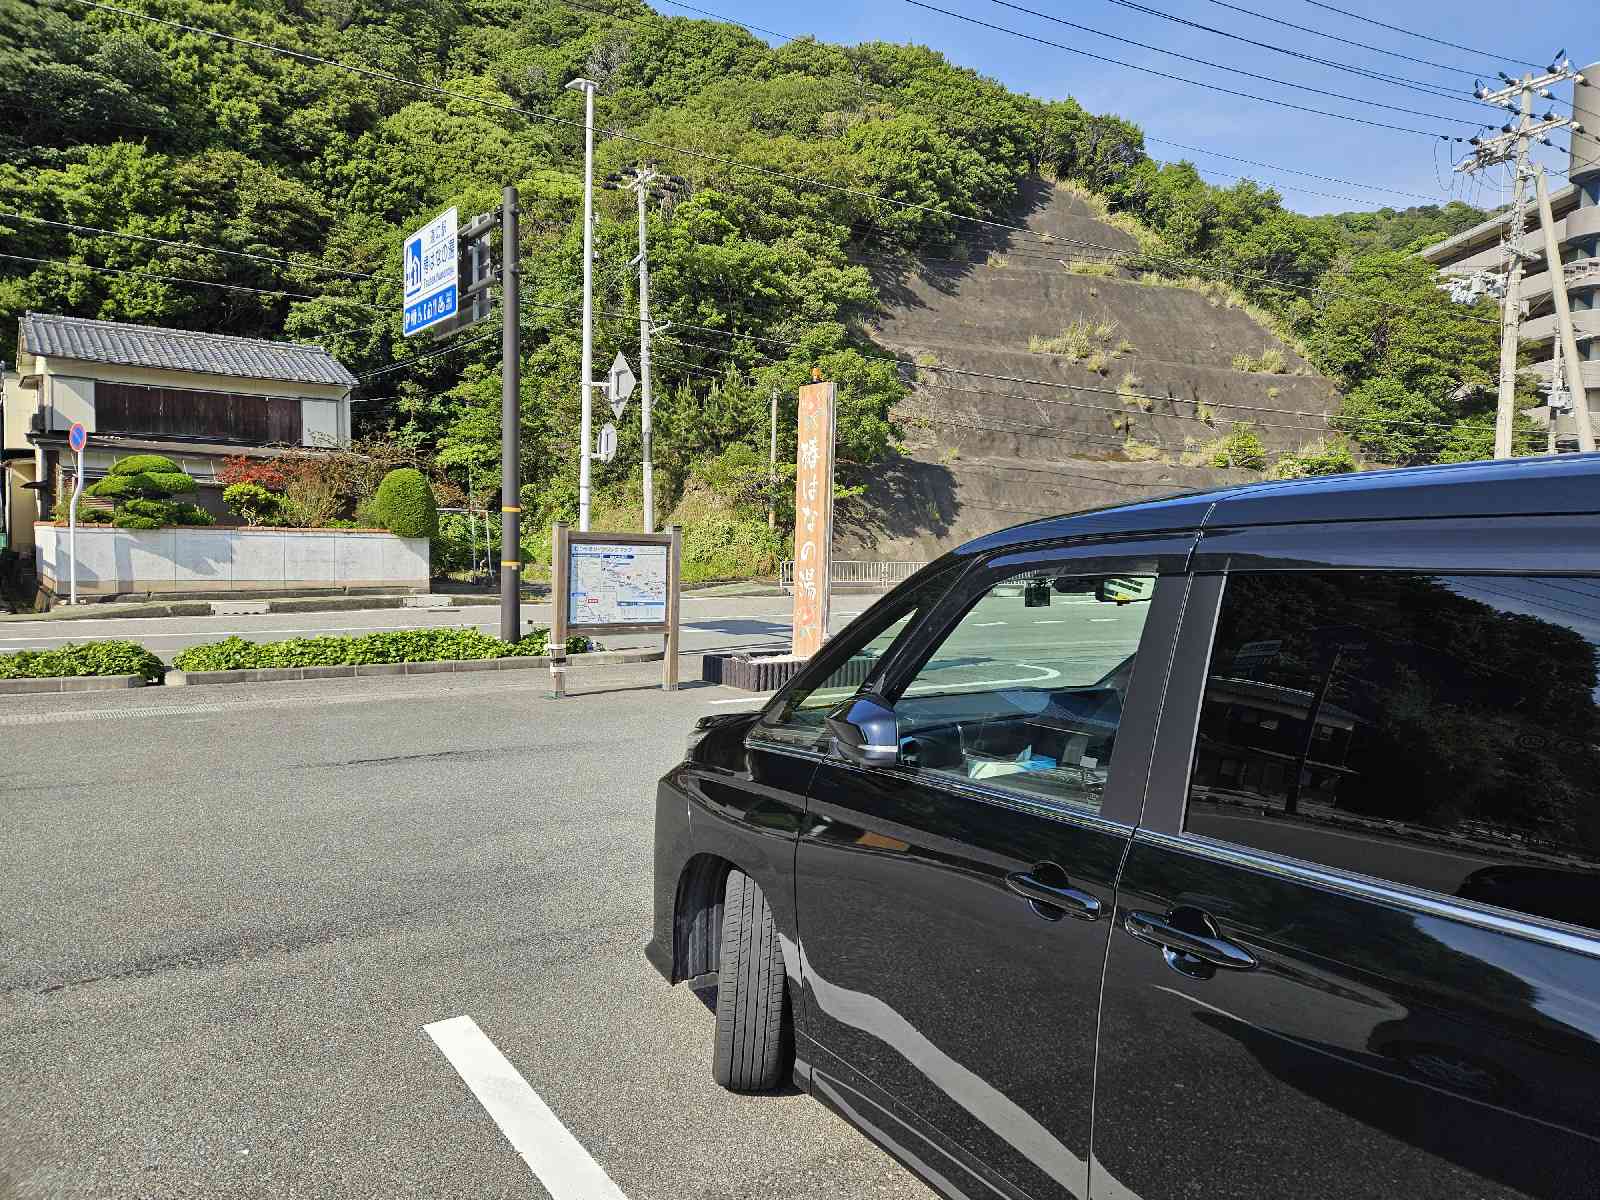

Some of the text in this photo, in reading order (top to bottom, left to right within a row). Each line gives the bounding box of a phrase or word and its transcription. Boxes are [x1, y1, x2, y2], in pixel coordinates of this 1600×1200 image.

[799, 436, 819, 600] 椿はなの湯
